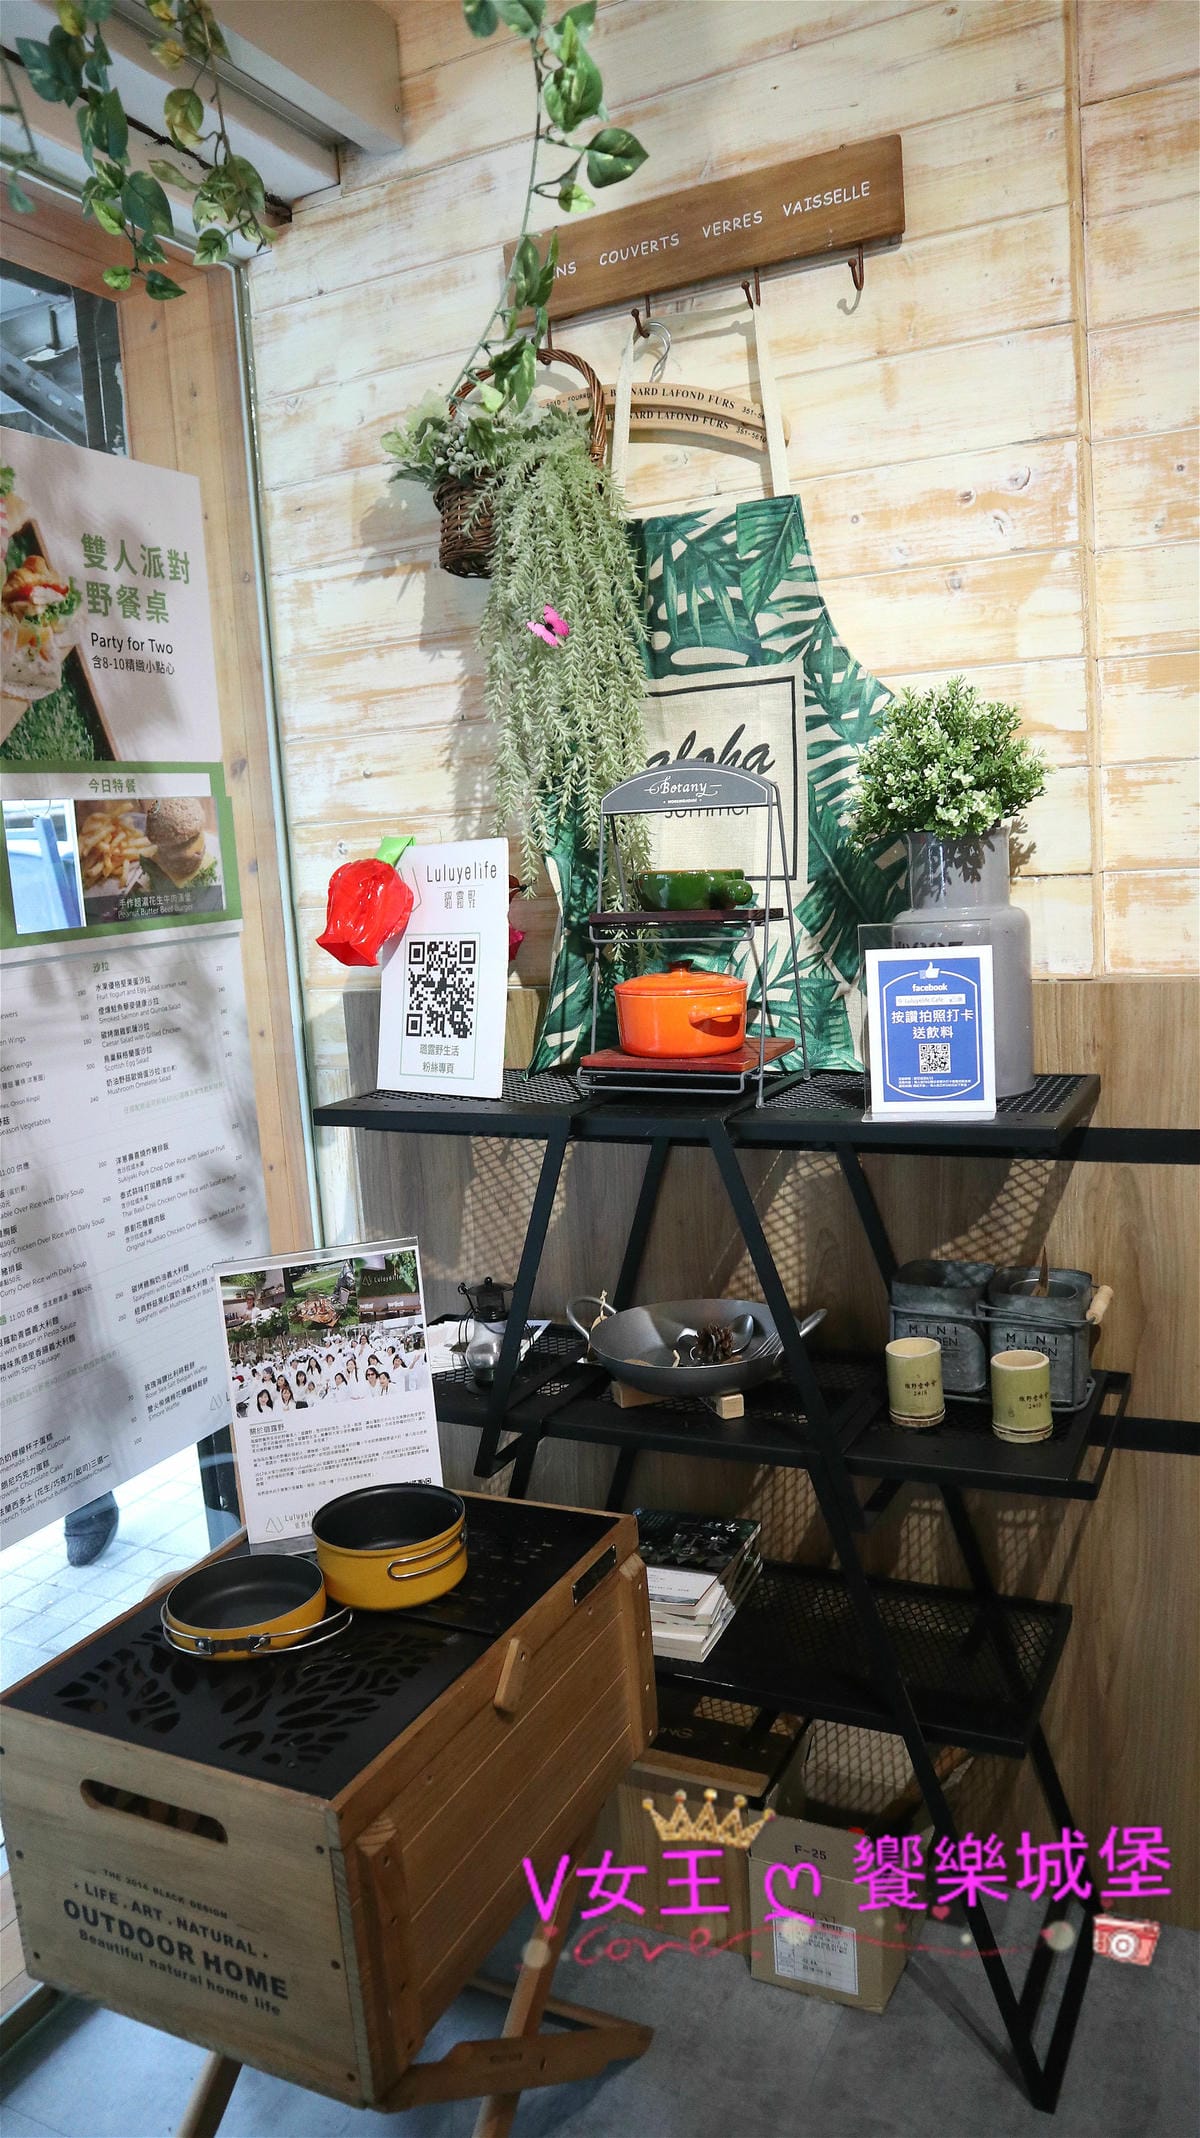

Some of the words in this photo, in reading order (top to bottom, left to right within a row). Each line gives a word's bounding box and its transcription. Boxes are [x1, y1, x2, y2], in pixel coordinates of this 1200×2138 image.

[599, 233, 680, 267] COUVERTS
[701, 210, 764, 239] VERRES
[781, 181, 871, 218] VAISSELLE
[661, 387, 705, 402] LAFOND
[708, 394, 736, 410] FURS
[657, 411, 699, 424] LAFOND
[702, 416, 729, 431] FURS
[80, 532, 190, 587] 雙人派對
[86, 580, 170, 625] 野餐桌
[90, 631, 124, 654] Party
[127, 636, 146, 653] for
[148, 638, 174, 655] Two
[92, 655, 175, 676] 含8-10精緻小點心
[88, 777, 137, 794] 今日特餐
[650, 775, 720, 797] Botany
[427, 861, 497, 884] Luluyelife
[140, 907, 159, 916] Butter
[160, 905, 173, 913] Beef
[912, 983, 948, 992] facebook
[891, 1008, 974, 1024] 按讚拍照打卡
[912, 1025, 954, 1040] 送飲料
[422, 1061, 454, 1074] 粉絲專頁
[909, 1324, 958, 1335] MINI
[1006, 1332, 1058, 1344] MINI
[794, 1845, 827, 1861] F-25
[103, 1868, 122, 1882] THE
[152, 1887, 185, 1905] BLACK
[190, 1900, 228, 1920] DESIGN
[84, 1883, 119, 1905] LIFE
[131, 1901, 163, 1921] ART
[176, 1917, 258, 1957] NATURAL
[63, 1899, 196, 1966] OUTDOOR
[202, 1950, 289, 2000] HOME
[79, 1928, 144, 1963] Beautiful
[148, 1958, 203, 1986] natural
[206, 1977, 249, 2004] home
[253, 1998, 281, 2016] life
